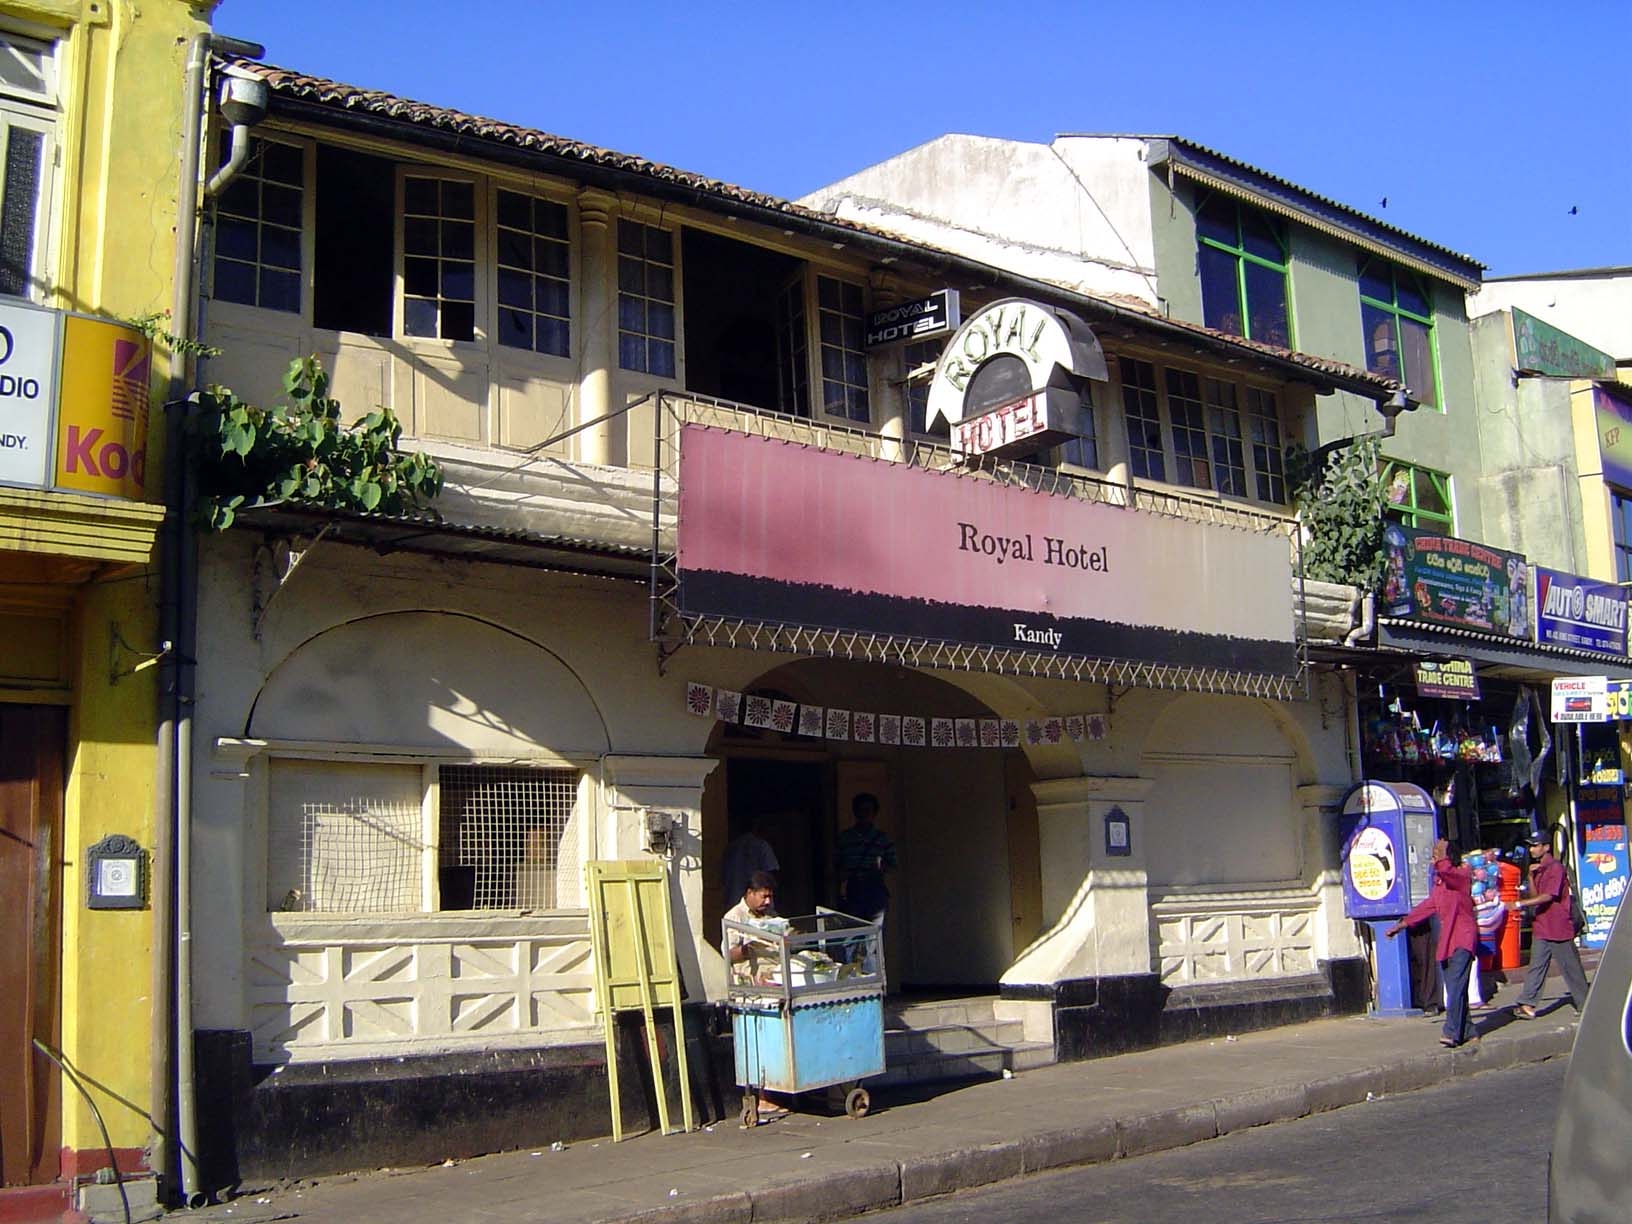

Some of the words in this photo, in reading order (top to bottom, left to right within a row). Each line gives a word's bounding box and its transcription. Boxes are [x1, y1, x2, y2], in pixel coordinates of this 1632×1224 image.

[875, 302, 938, 326] ROYAL
[867, 316, 946, 343] HOTEL
[945, 305, 1048, 391] ROYAL
[959, 397, 1044, 452] HOTEL
[957, 523, 1034, 564] Royal
[1044, 537, 1109, 572] Hotel
[1545, 585, 1584, 620] AUTO
[1585, 594, 1626, 627] SMART
[1014, 624, 1062, 649] Kandy
[1417, 670, 1442, 684] TRADE
[1443, 673, 1474, 688] CENTRE
[1554, 682, 1586, 691] VEHICLE
